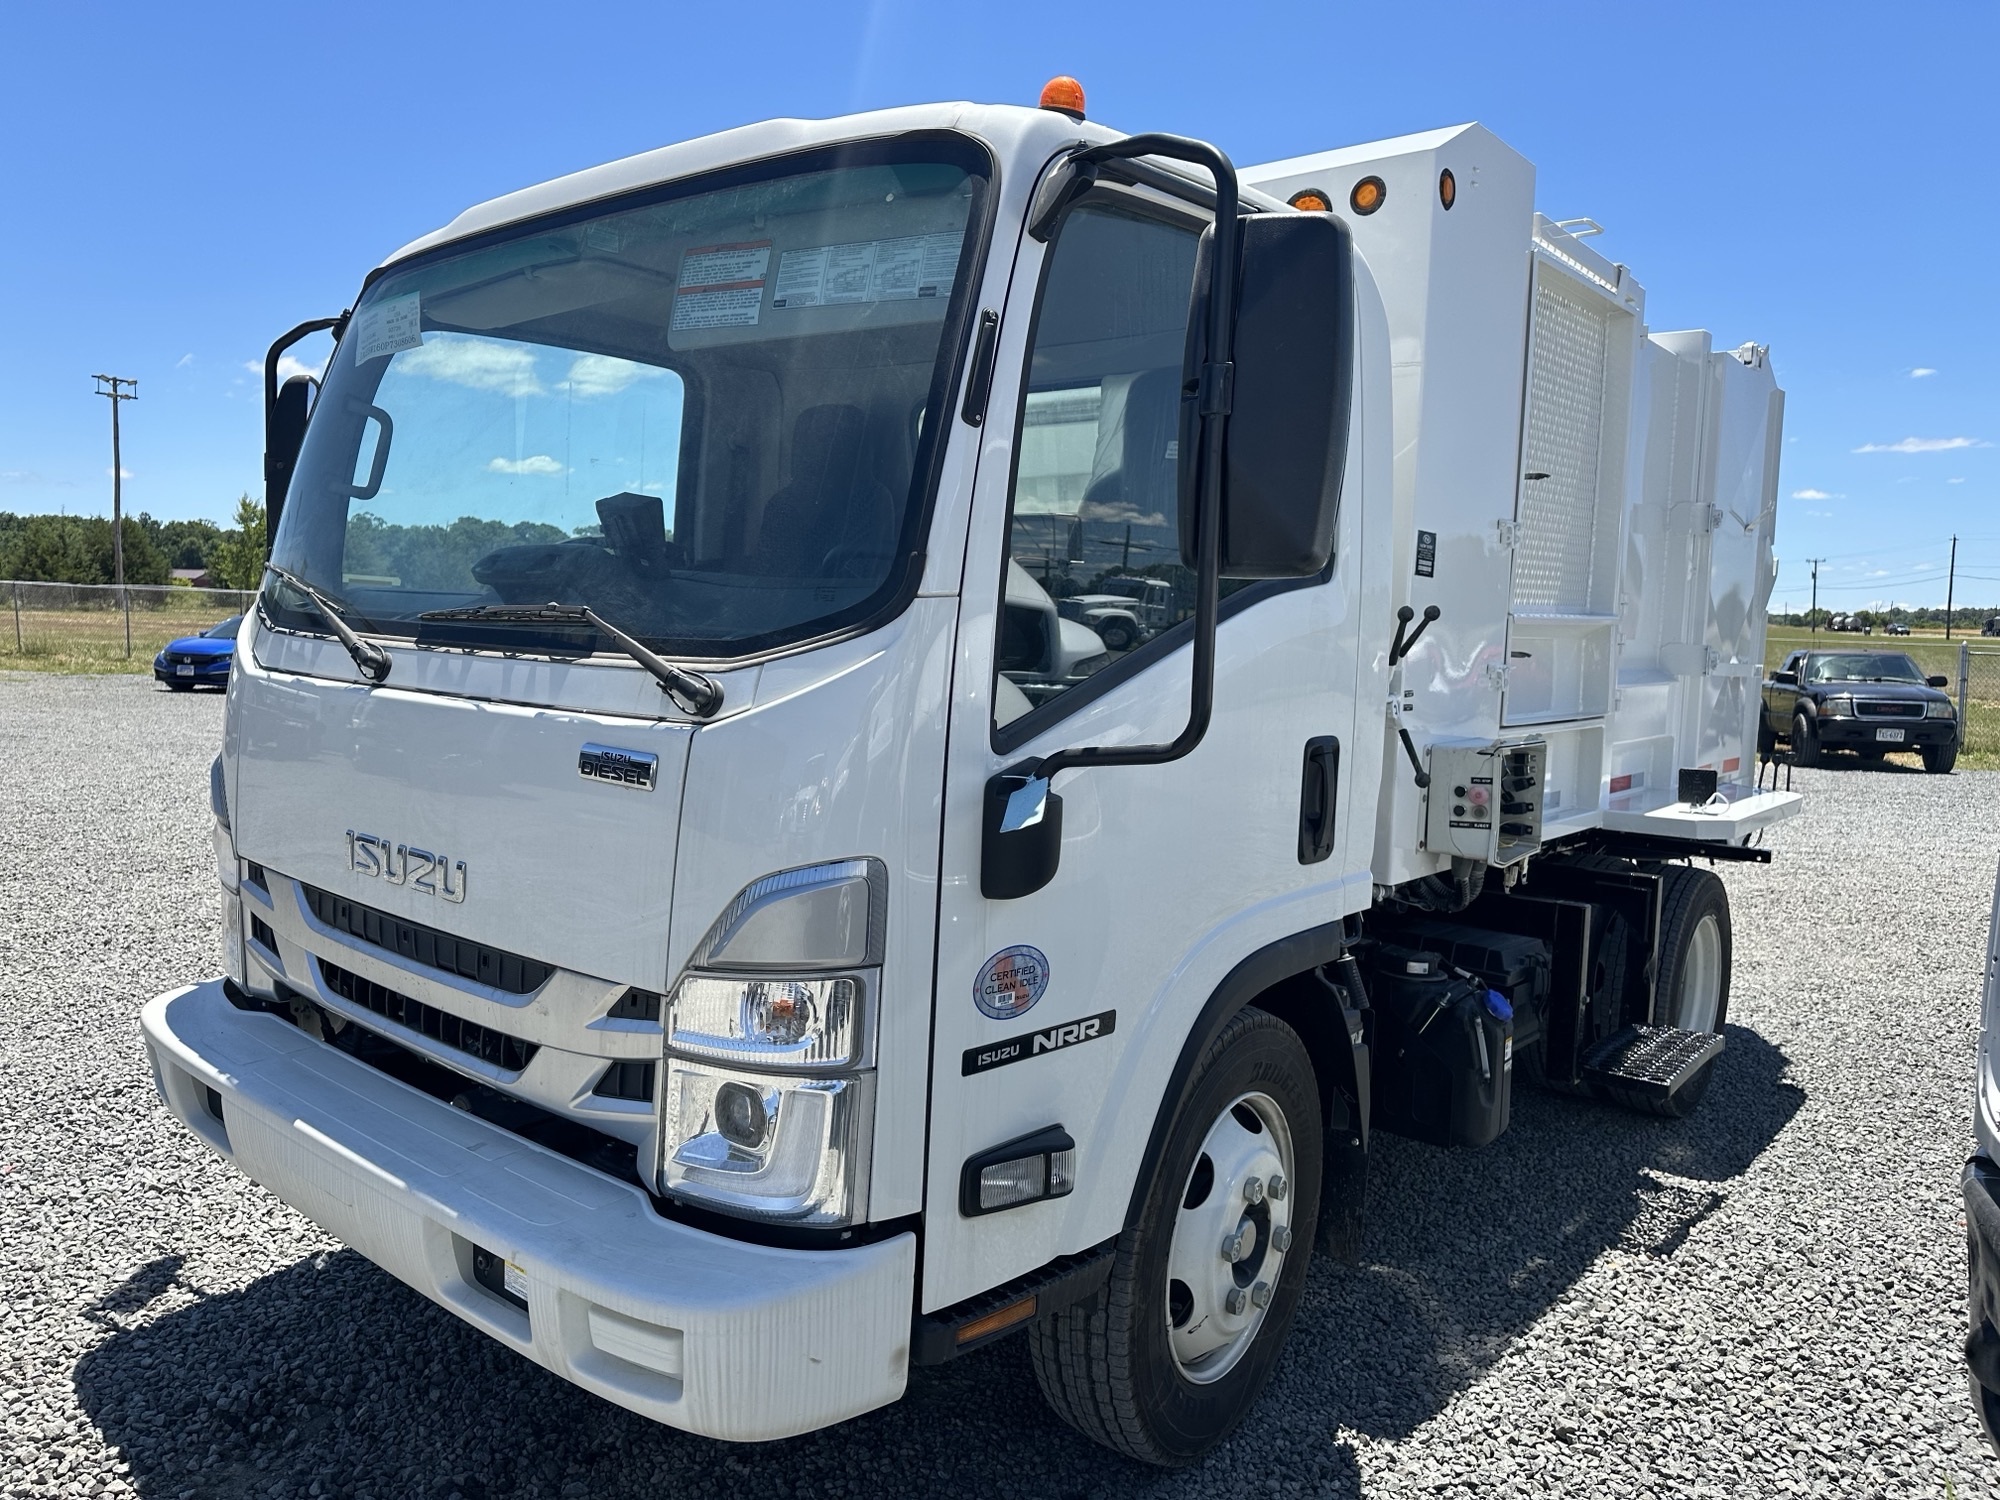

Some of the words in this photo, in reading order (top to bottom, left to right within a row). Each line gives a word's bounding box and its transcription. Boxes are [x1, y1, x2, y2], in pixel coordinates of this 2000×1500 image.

[600, 751, 631, 764] ISUZU
[580, 761, 648, 786] DIESEL
[345, 829, 467, 904] ISUZU
[990, 965, 1036, 982] CERTIFIED
[985, 980, 1016, 995] CLEAN
[1019, 976, 1039, 988] IDLE
[977, 1044, 1020, 1066] ISUZU
[1032, 1018, 1100, 1054] NRR
